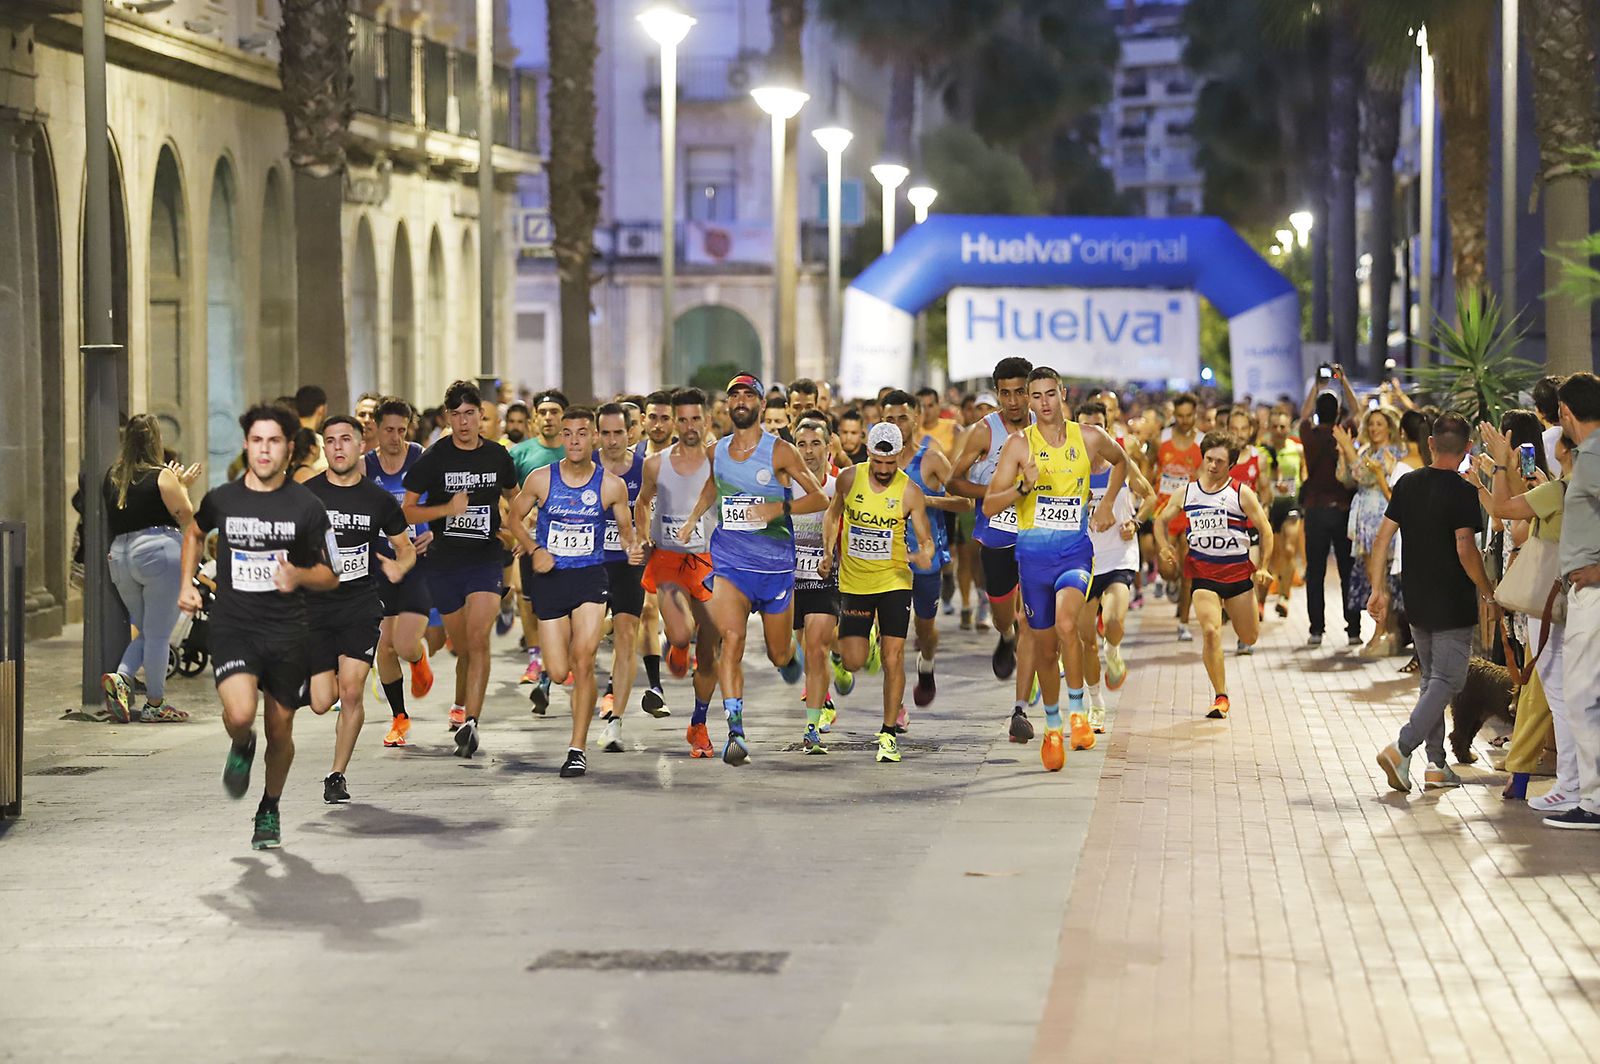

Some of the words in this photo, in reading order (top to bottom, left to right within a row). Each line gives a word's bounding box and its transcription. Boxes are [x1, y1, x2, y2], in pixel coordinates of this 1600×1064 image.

[961, 233, 1072, 263] Huelva
[1080, 233, 1188, 271] original
[965, 298, 1163, 345] Huelva
[445, 474, 463, 486] RUN
[465, 473, 480, 485] FOR
[482, 473, 497, 484] FUN
[1033, 484, 1053, 492] VOS
[352, 514, 371, 527] FUN
[1003, 511, 1017, 524] 75
[1047, 508, 1069, 521] 249
[274, 521, 296, 537] FUN
[458, 517, 478, 529] 604
[1199, 518, 1217, 530] 303
[563, 536, 577, 548] 13
[605, 531, 619, 542] 47
[858, 539, 879, 552] 655
[343, 559, 357, 572] 66
[247, 566, 272, 580] 198
